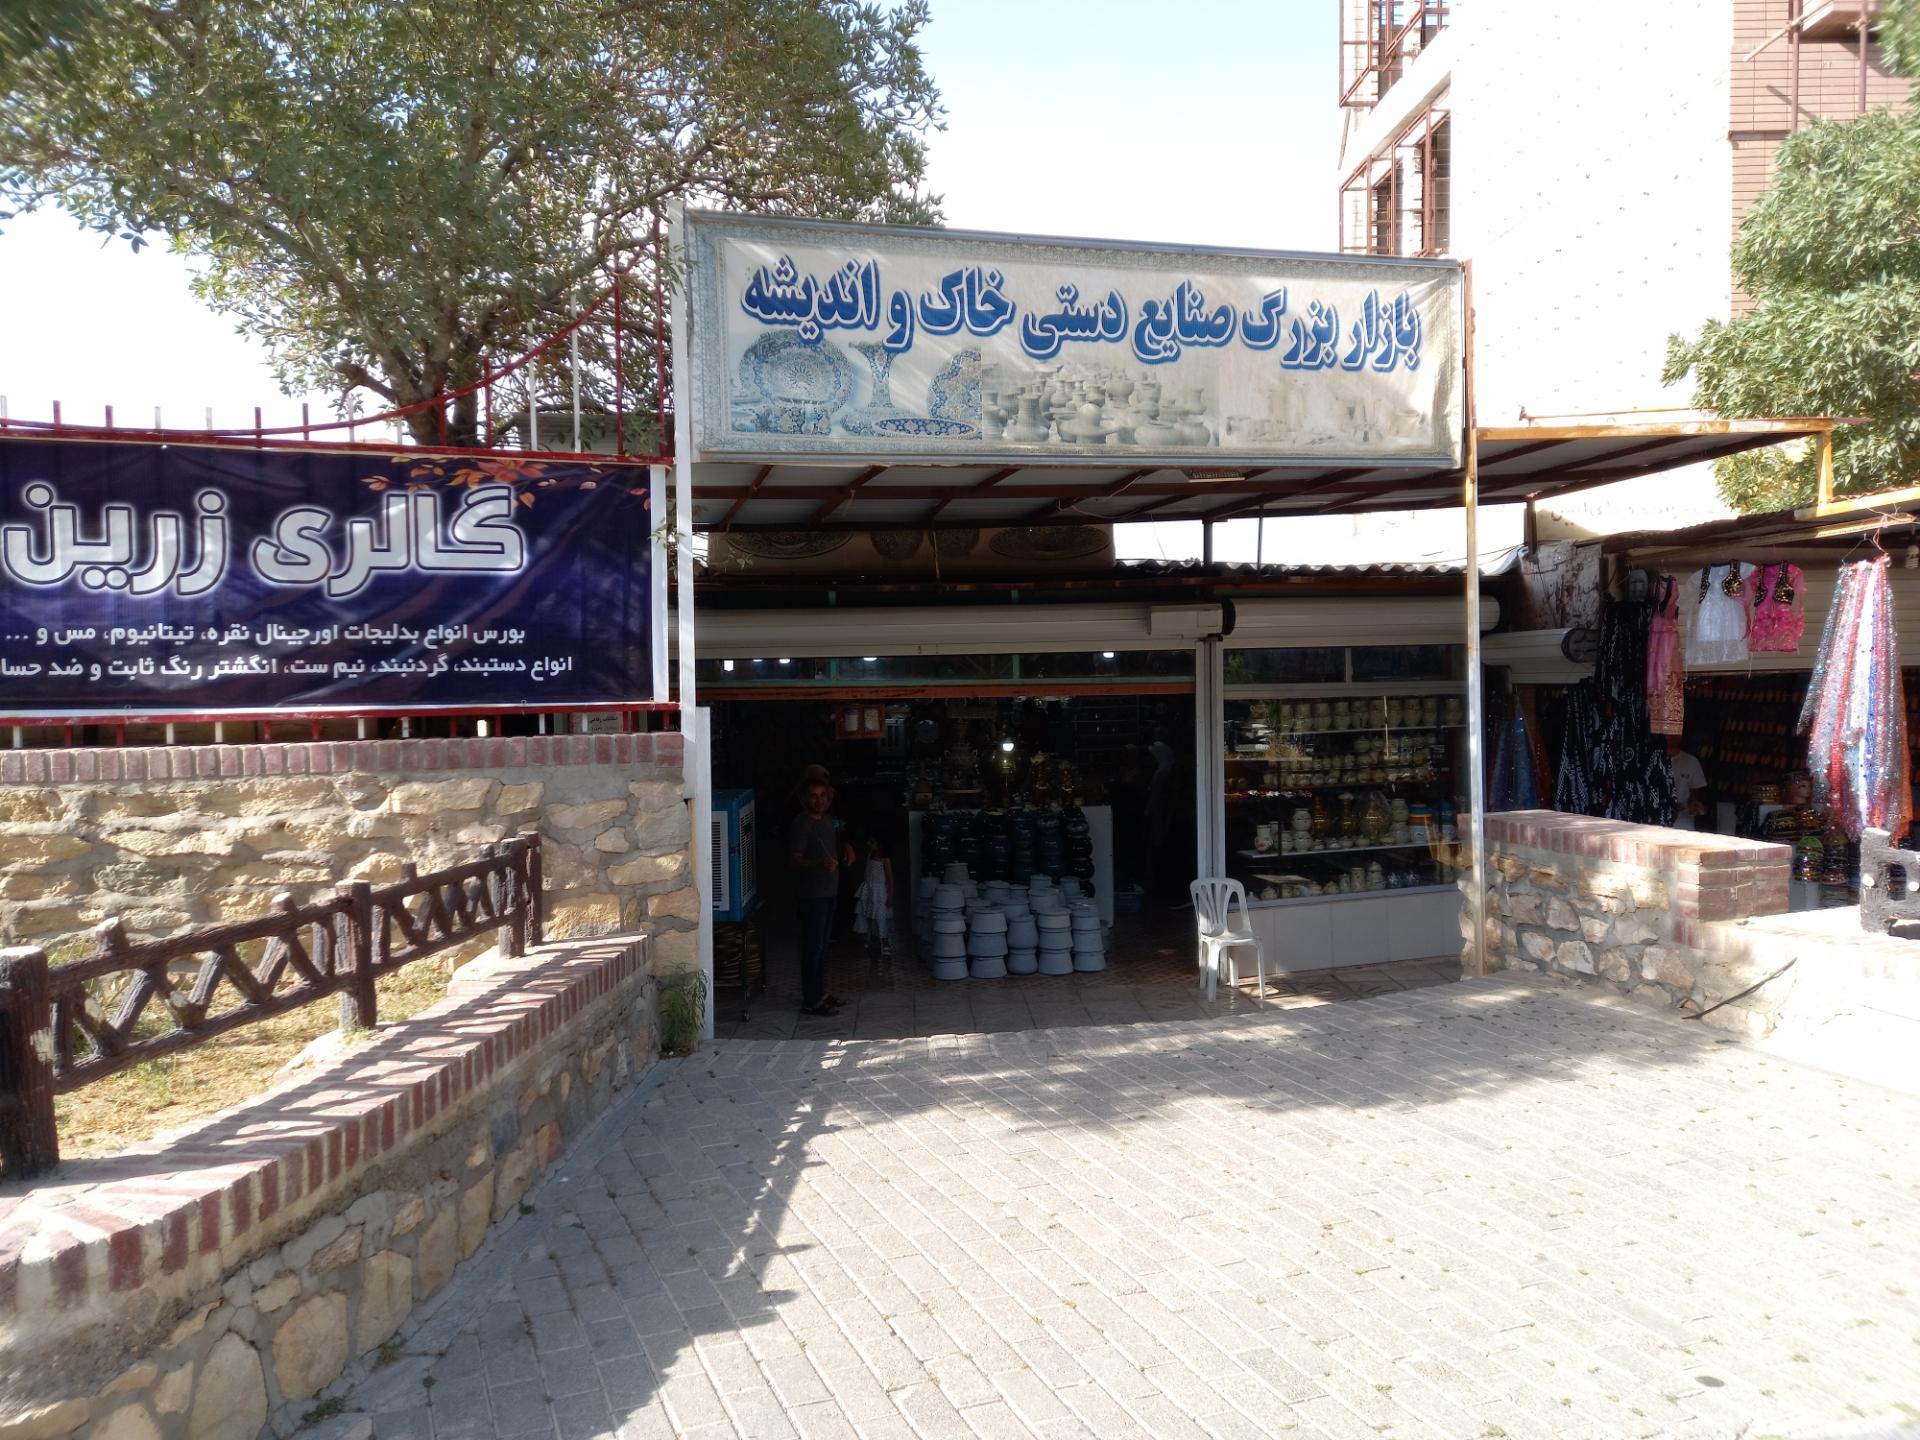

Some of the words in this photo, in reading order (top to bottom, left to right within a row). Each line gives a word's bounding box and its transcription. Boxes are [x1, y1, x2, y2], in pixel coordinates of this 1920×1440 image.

[741, 254, 880, 346] اندیشه
[916, 266, 1016, 336] خاک
[882, 289, 915, 352] و
[1021, 282, 1128, 360] دستی
[1130, 278, 1238, 363] صنایع
[1240, 285, 1339, 370] بزرگ
[1342, 286, 1421, 371] بازار
[3, 483, 227, 596] زرین
[253, 485, 524, 597] گالری
[36, 627, 48, 645] و
[54, 626, 97, 645] مس
[103, 622, 195, 645] تیتانیوم،
[201, 623, 250, 645] نقره،
[255, 623, 338, 645] اورجینال
[344, 623, 419, 645] بدلیجات
[423, 624, 468, 649] انواع
[473, 627, 526, 645] بورس
[48, 657, 83, 677] ضد
[90, 662, 102, 680] و
[108, 656, 154, 678] ثابت
[160, 654, 202, 680] رنگ
[208, 654, 277, 680] انگشتر
[283, 656, 328, 673] ست،
[333, 656, 365, 678] نیم
[371, 652, 448, 678] گردنبند،
[454, 656, 527, 677] دستبند،
[530, 656, 572, 681] انواع
